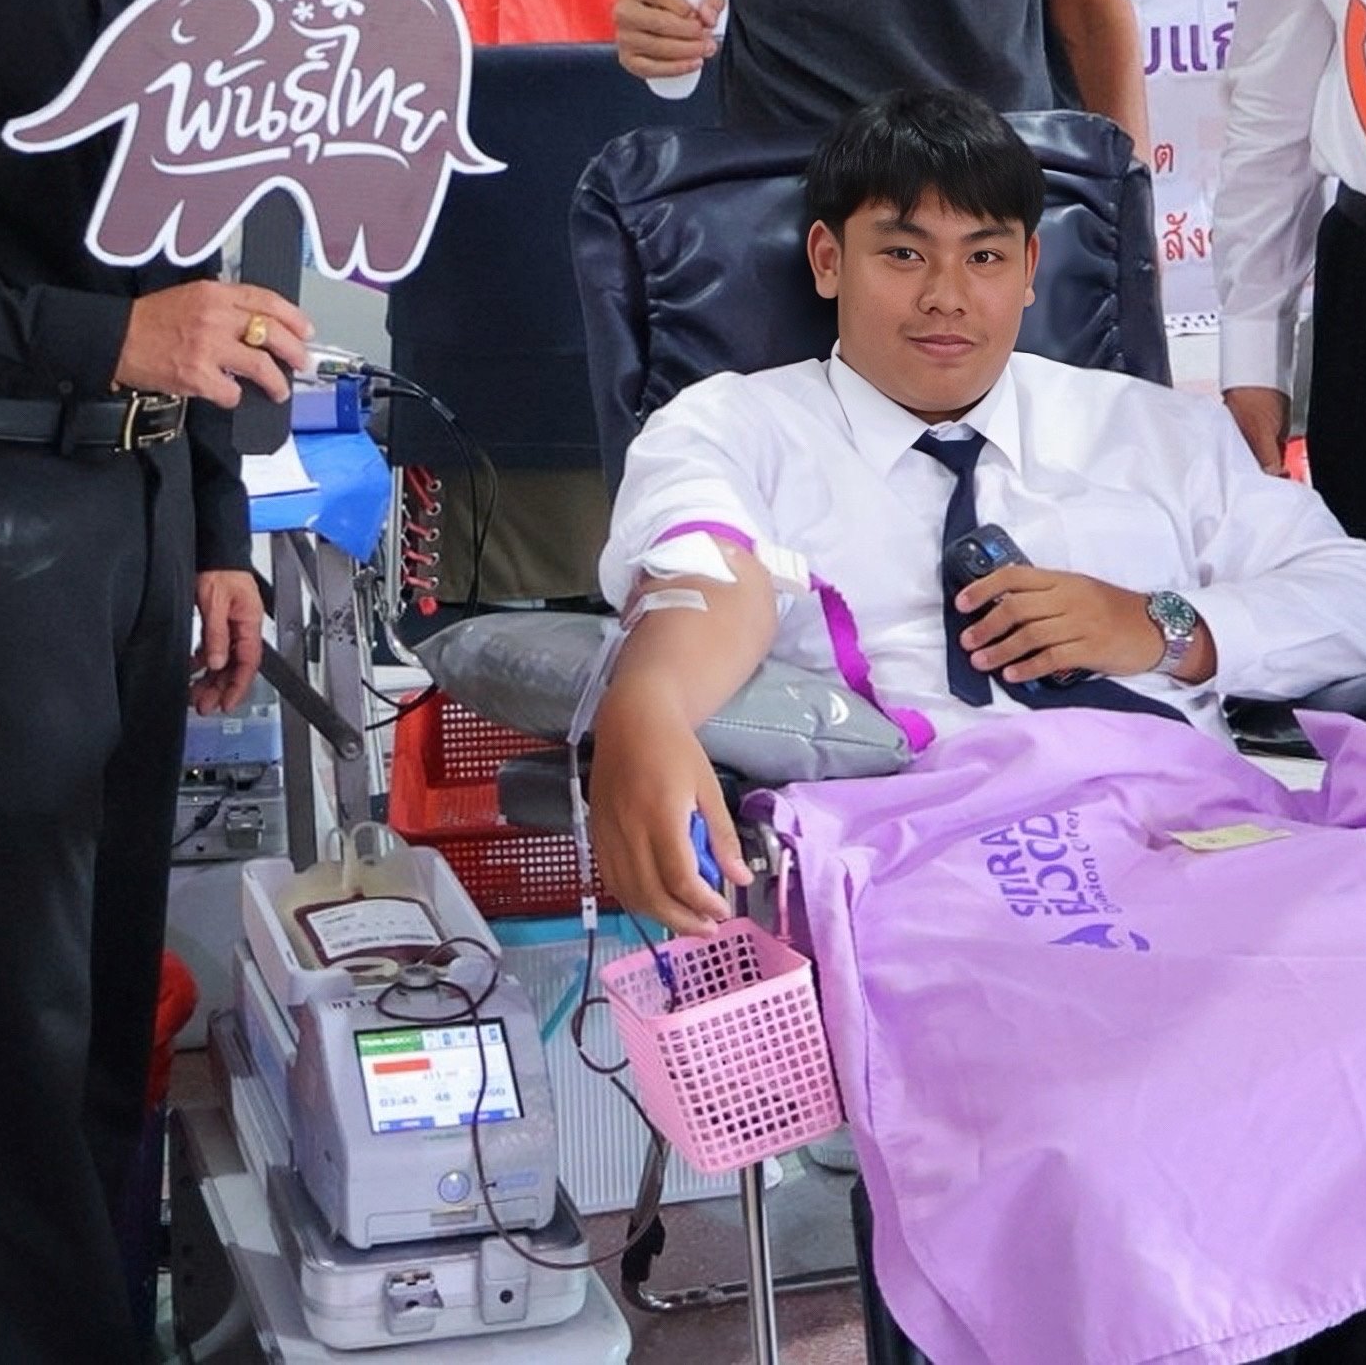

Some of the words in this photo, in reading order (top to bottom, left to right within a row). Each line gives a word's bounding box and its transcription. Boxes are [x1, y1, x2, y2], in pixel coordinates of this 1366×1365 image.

[145, 20, 448, 165] พันธุ์ไทย
[1162, 211, 1213, 261] สัง
